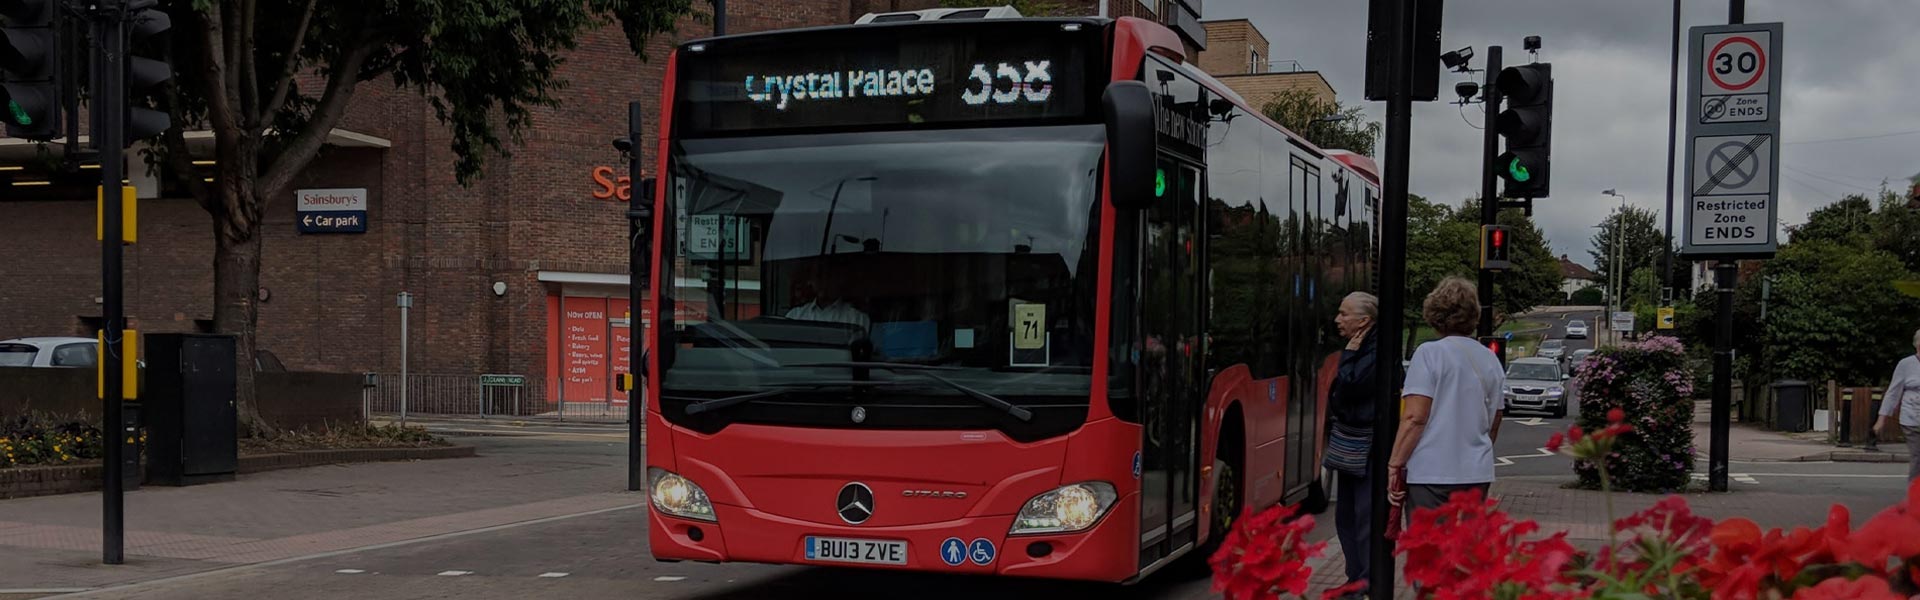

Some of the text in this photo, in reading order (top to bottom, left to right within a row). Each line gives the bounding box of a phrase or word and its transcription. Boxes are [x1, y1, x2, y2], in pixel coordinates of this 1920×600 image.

[1715, 52, 1756, 74] 30
[1706, 103, 1763, 117] 20 ENDS
[303, 193, 358, 206] Sainsbury's
[1696, 199, 1765, 211] Restricted
[315, 215, 358, 228] Car park
[1714, 213, 1746, 223] Zone
[1705, 226, 1755, 239] ENDS
[566, 311, 603, 319] NOW OPEN
[1023, 320, 1038, 339] 71
[902, 489, 968, 498] CITARO
[820, 540, 900, 561] BU13 ZVE
